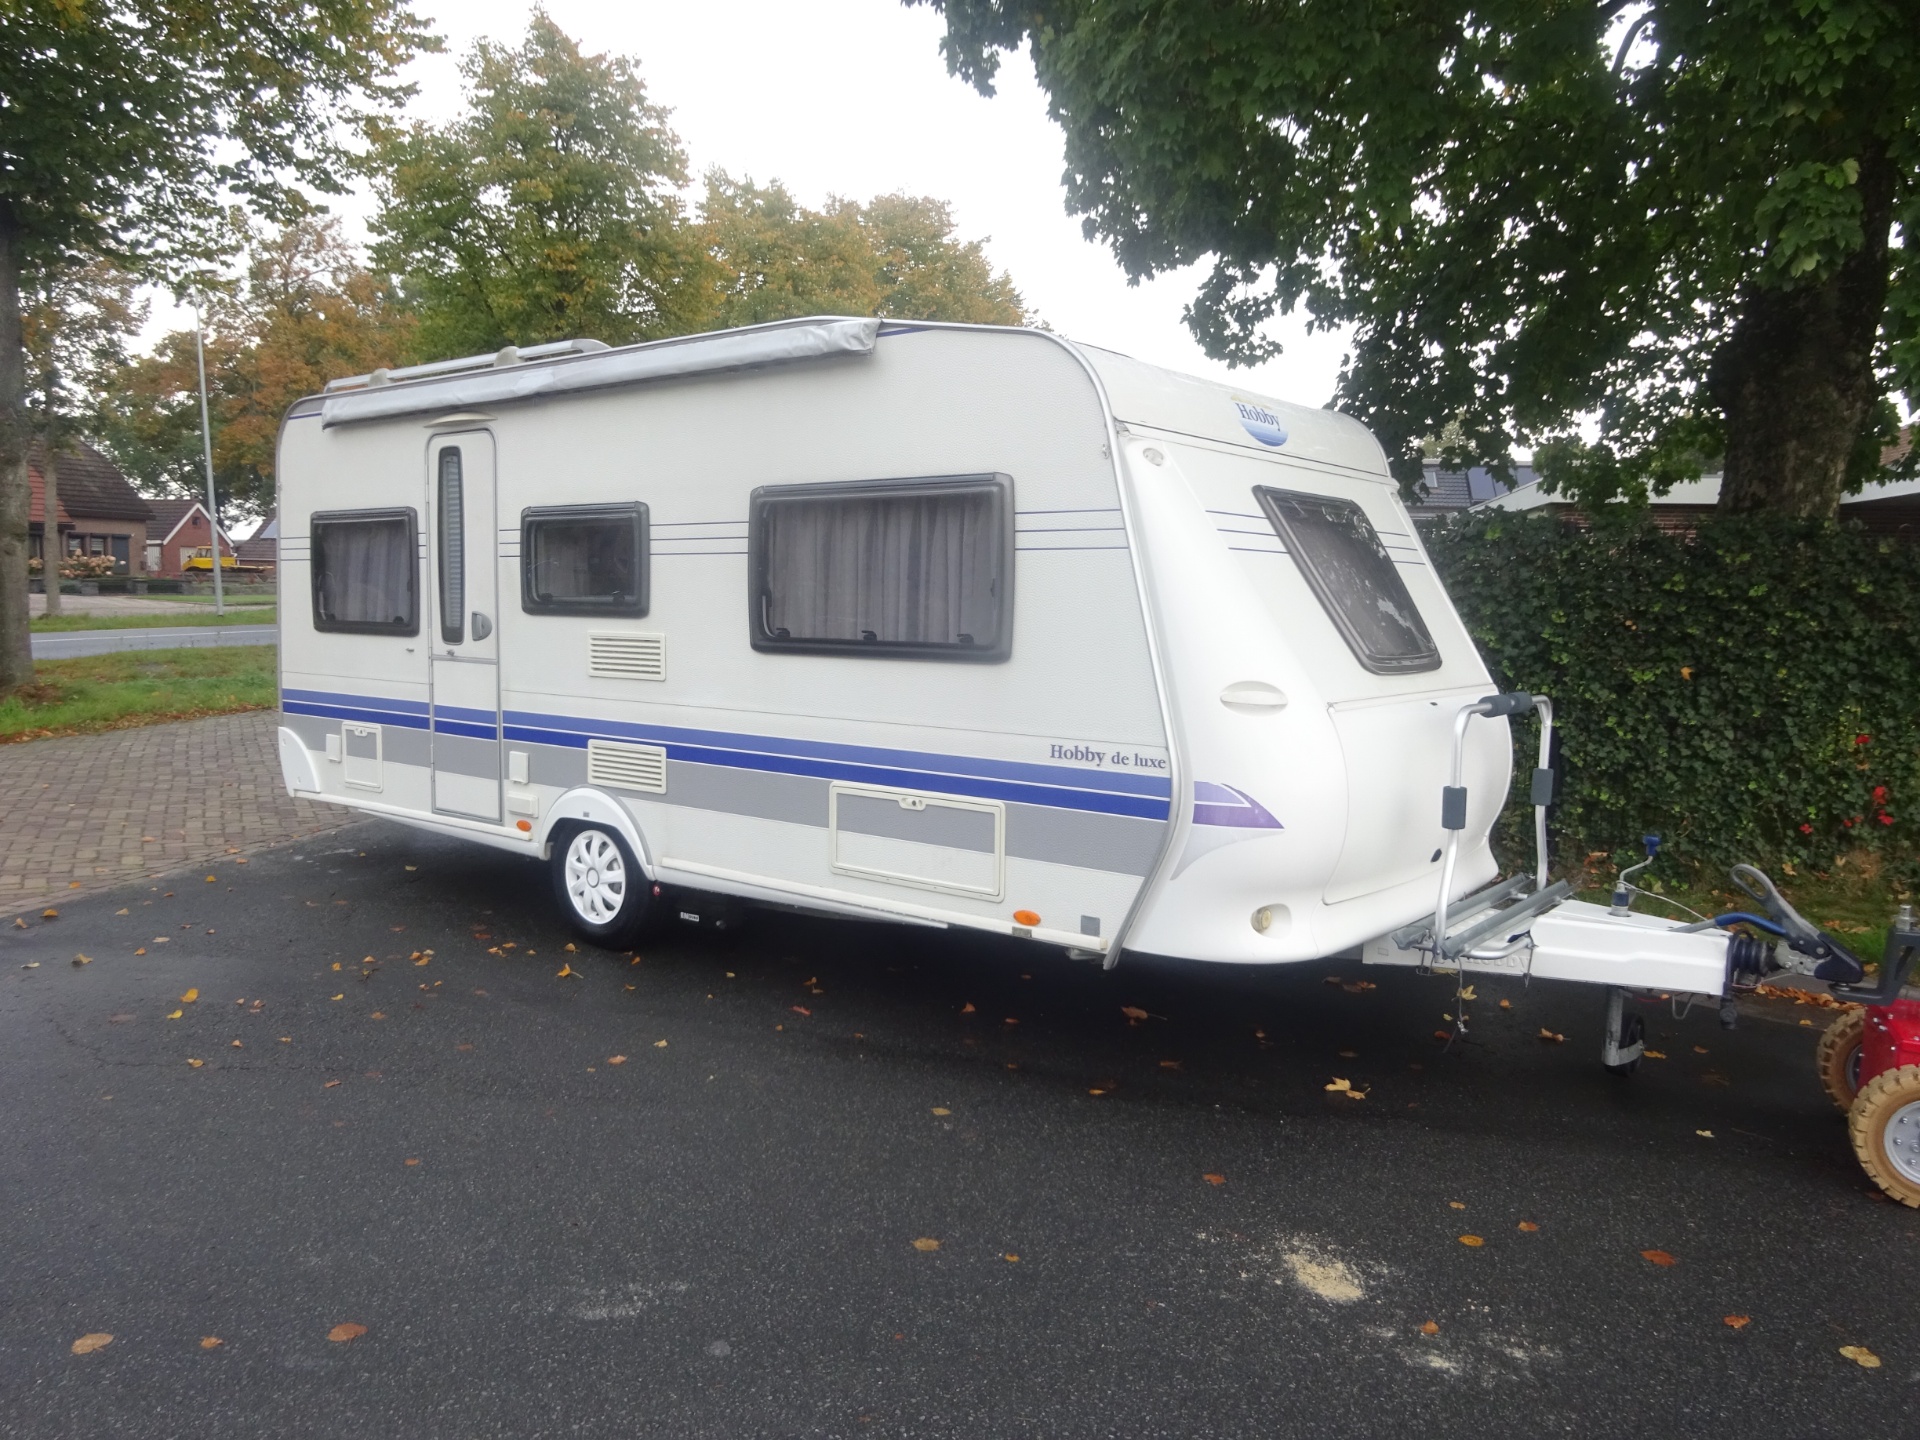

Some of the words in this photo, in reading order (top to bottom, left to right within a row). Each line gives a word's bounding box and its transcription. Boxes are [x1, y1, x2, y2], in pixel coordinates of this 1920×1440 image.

[1234, 402, 1281, 432] Hobby
[1050, 744, 1106, 767] Hobby
[1111, 751, 1130, 766] de
[1134, 753, 1166, 769] luxe
